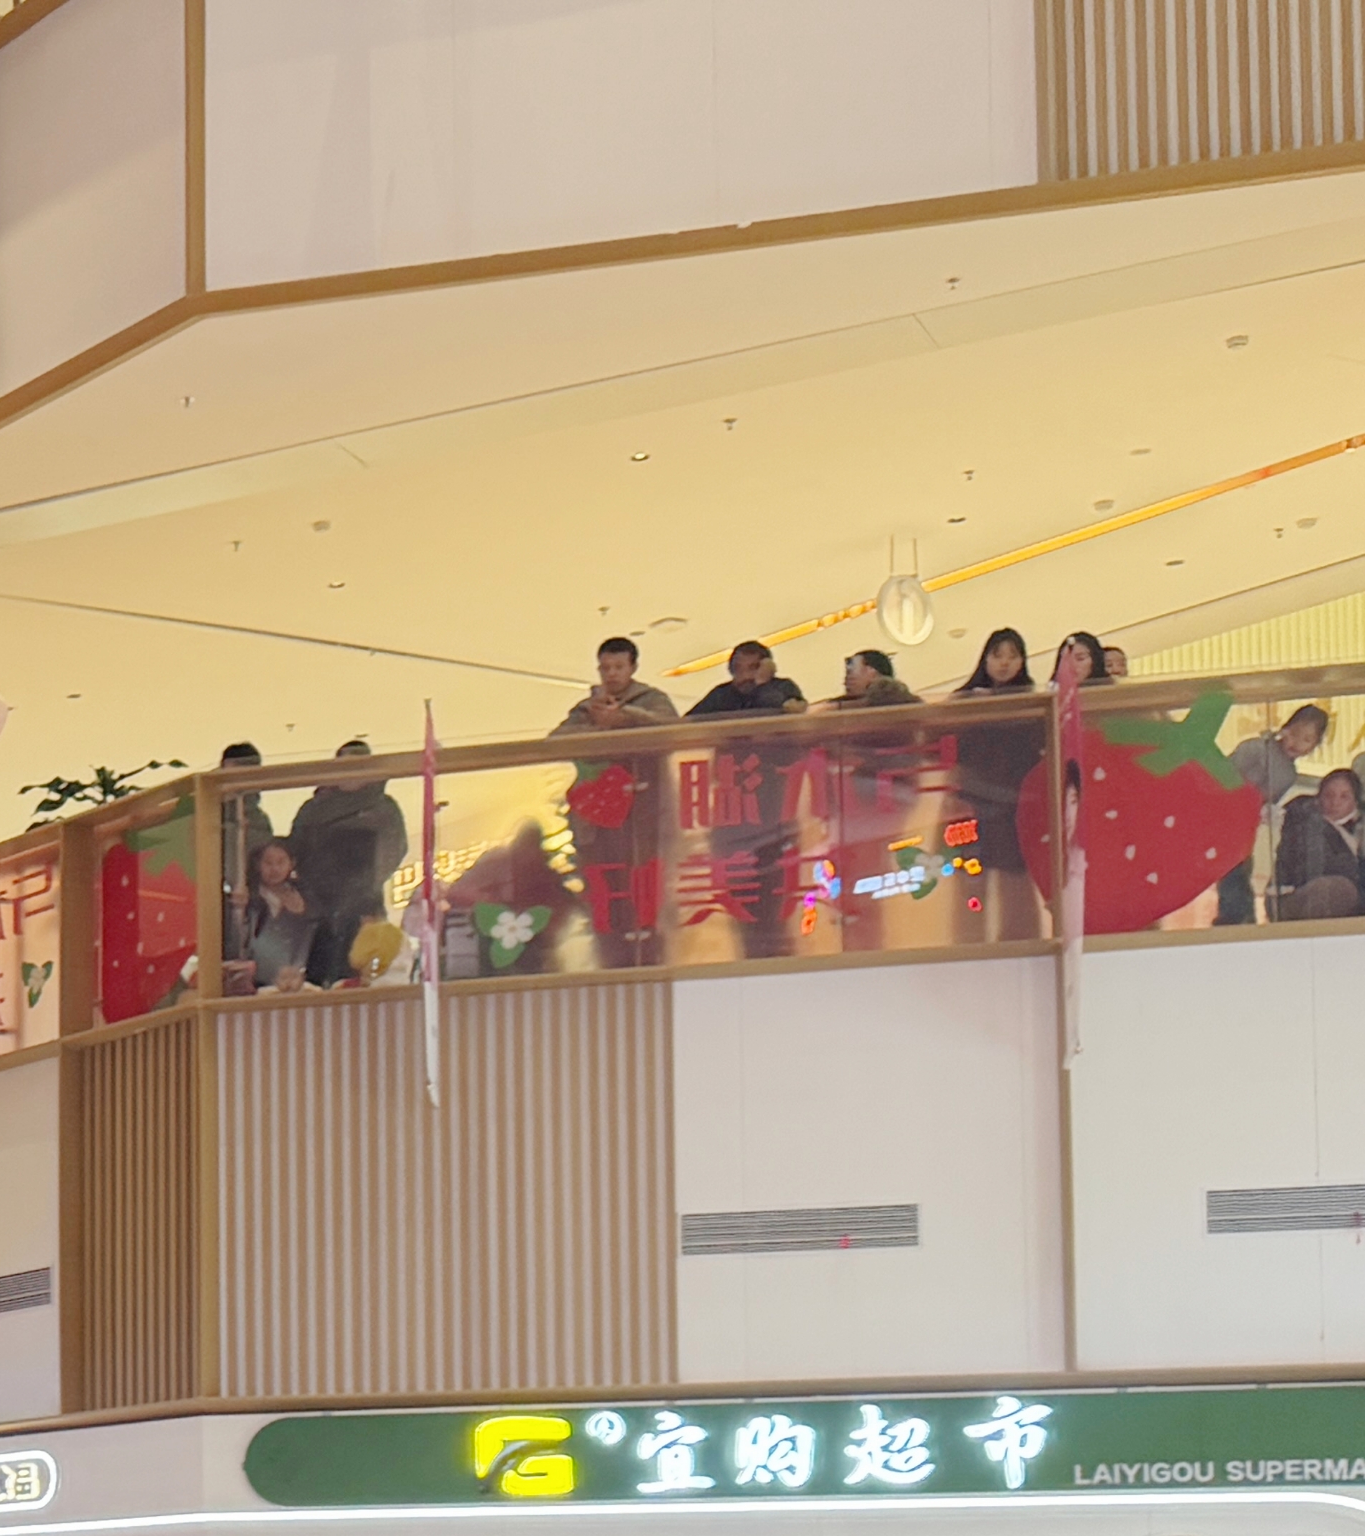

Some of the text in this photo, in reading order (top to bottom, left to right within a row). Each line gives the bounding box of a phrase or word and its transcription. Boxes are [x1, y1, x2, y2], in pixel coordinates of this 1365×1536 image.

[636, 1396, 1054, 1494] 宜购超市
[1074, 1461, 1216, 1486] LAIYIGOU
